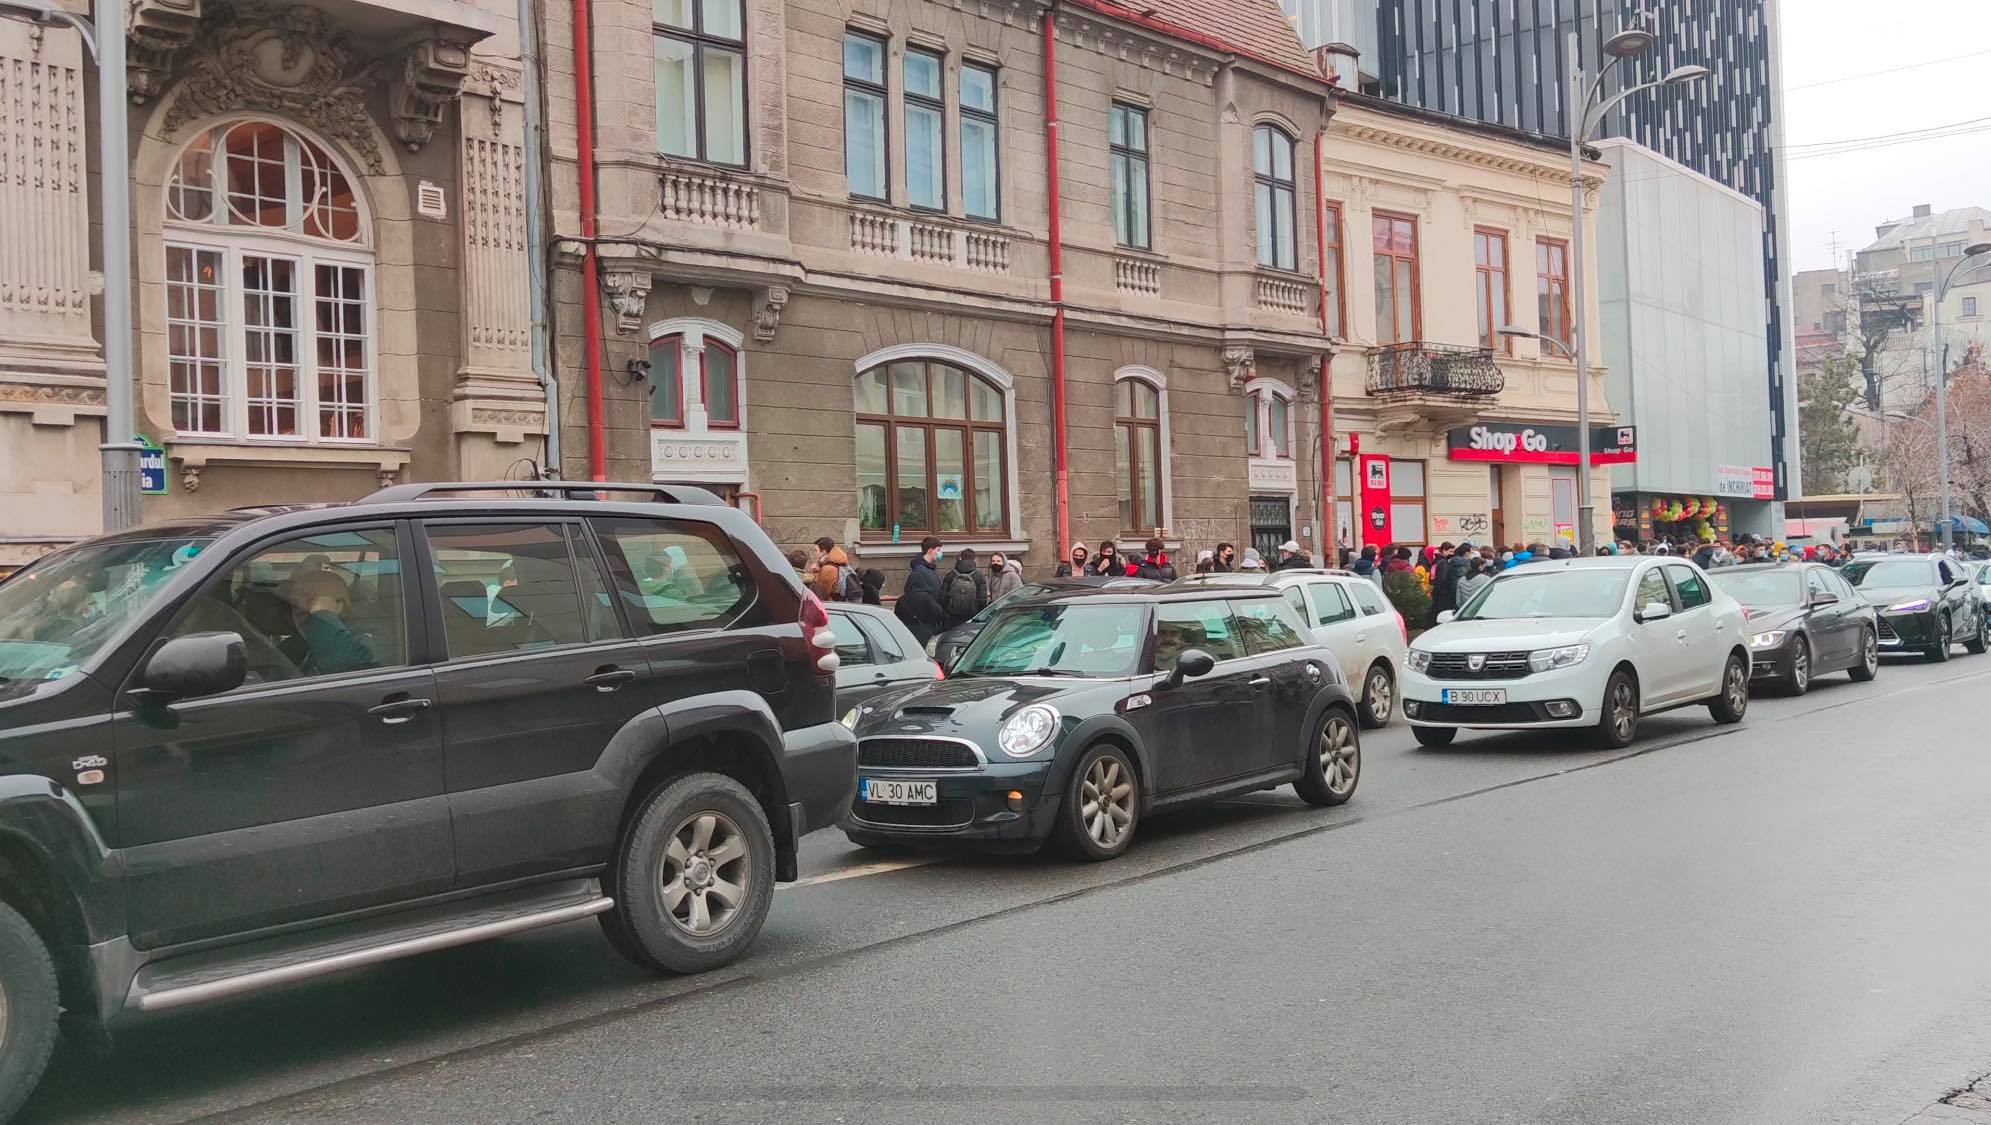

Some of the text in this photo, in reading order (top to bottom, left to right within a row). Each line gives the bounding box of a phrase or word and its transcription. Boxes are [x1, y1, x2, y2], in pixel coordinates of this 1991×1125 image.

[141, 472, 153, 488] ia
[1450, 691, 1458, 702] B
[1461, 691, 1474, 702] 90
[1476, 691, 1500, 702] UCX
[868, 782, 883, 799] VL
[888, 783, 903, 800] 30
[907, 784, 934, 800] AMC
